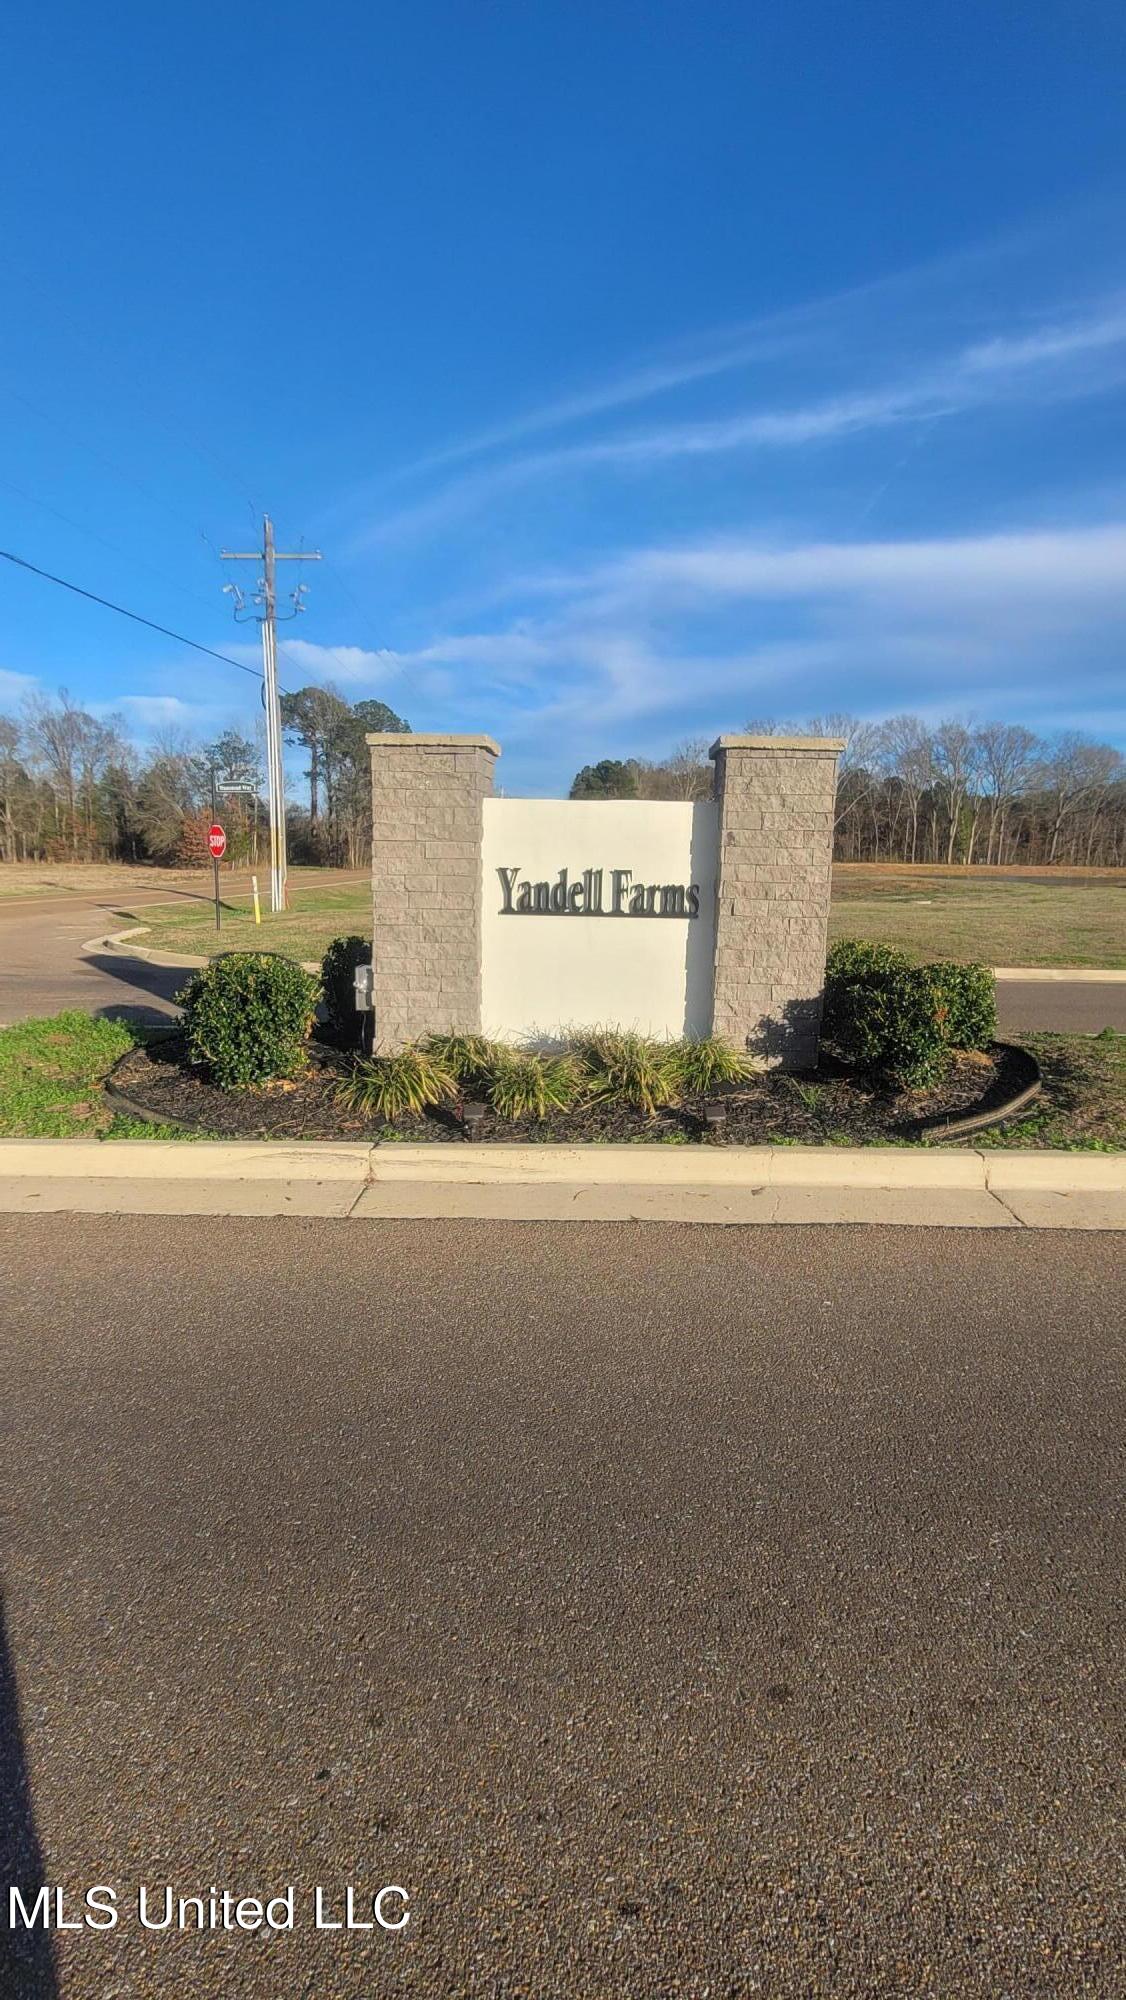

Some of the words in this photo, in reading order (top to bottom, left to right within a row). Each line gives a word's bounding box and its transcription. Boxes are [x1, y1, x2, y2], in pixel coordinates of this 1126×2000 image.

[209, 835, 225, 847] STOP
[495, 867, 604, 915] Yandell
[609, 869, 700, 918] Farms
